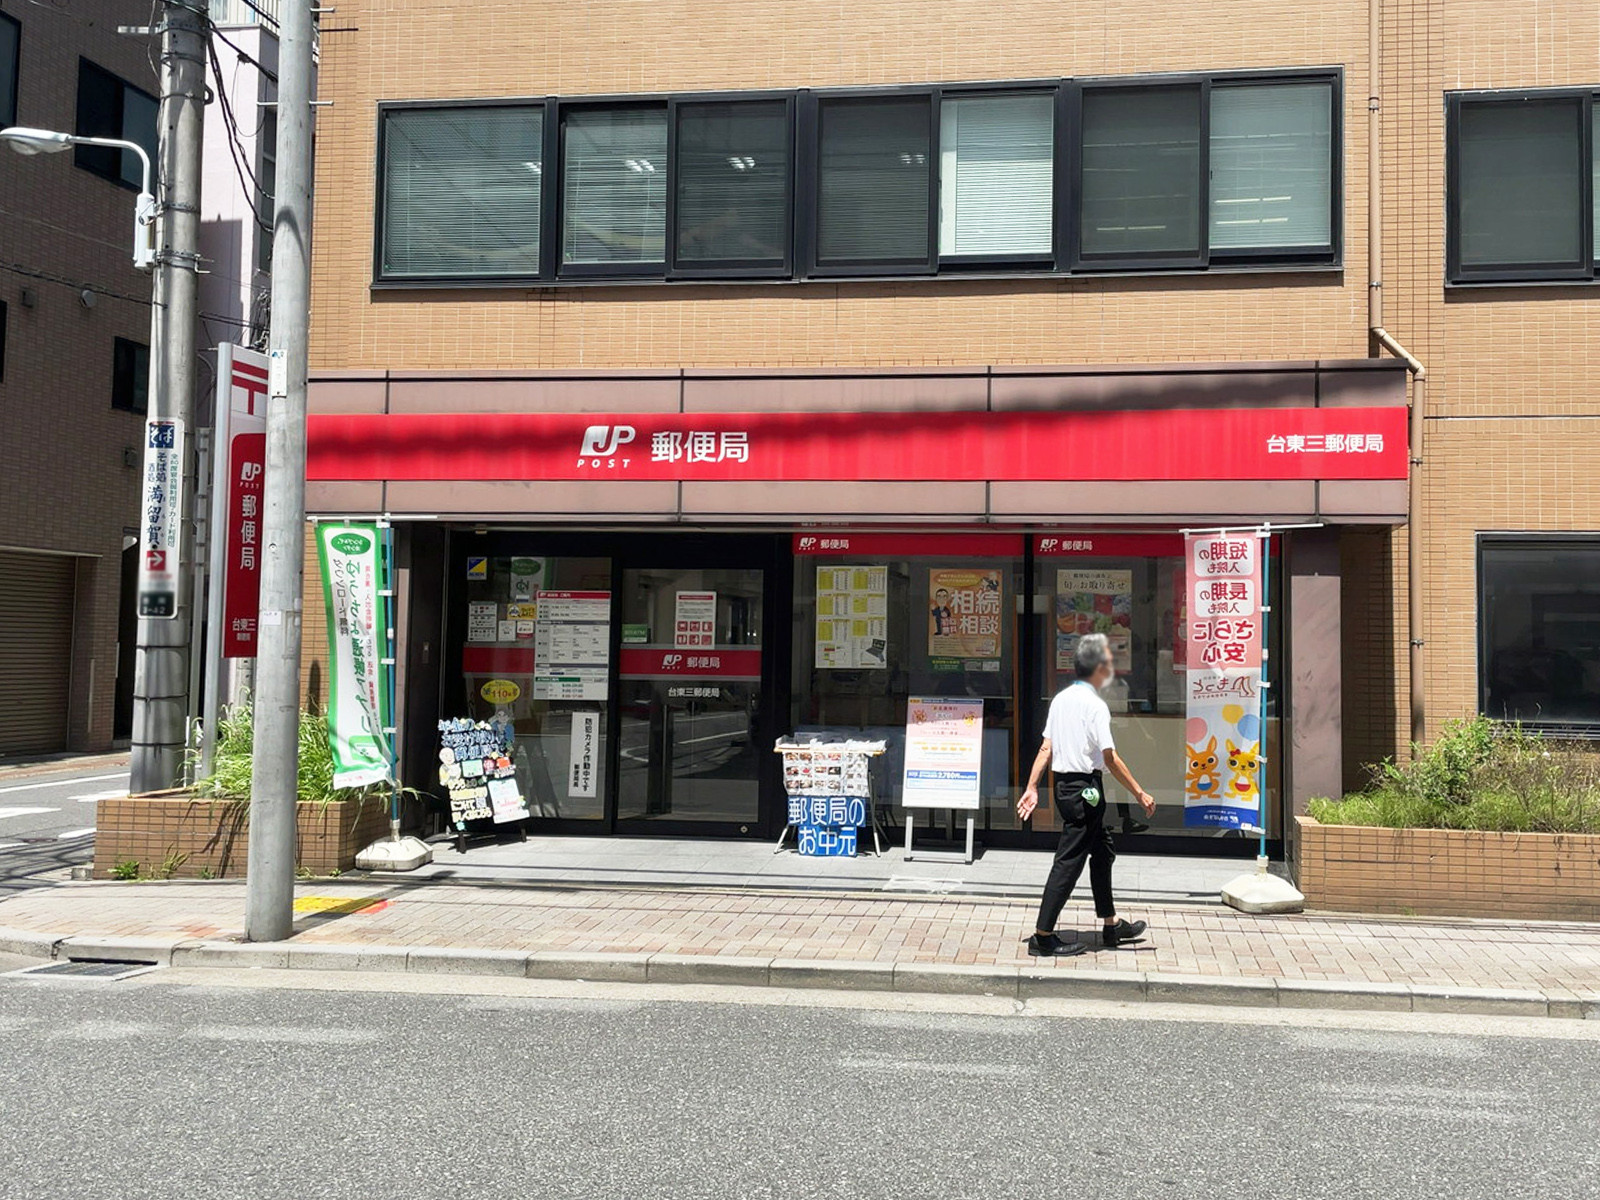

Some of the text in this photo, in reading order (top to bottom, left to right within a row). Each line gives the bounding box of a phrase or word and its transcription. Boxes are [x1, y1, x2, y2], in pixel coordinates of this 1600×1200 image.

[651, 431, 749, 463] 郵便局
[1266, 434, 1384, 453] 台東三郵便局
[577, 459, 631, 468] POST
[239, 482, 260, 490] POST
[147, 485, 164, 546] 満留賀
[240, 494, 257, 570] 郵便局
[820, 539, 849, 550] 郵便局
[1062, 541, 1093, 551] 郵便局
[951, 590, 999, 615] 相続
[232, 617, 256, 633] 台東三
[959, 615, 999, 636] 相談
[687, 656, 720, 669] 郵便局
[668, 687, 720, 698] 台東三郵便局
[583, 718, 593, 792] 防犯カメラ作動中です
[789, 797, 865, 826] 郵便局の
[799, 826, 856, 855] お中元
